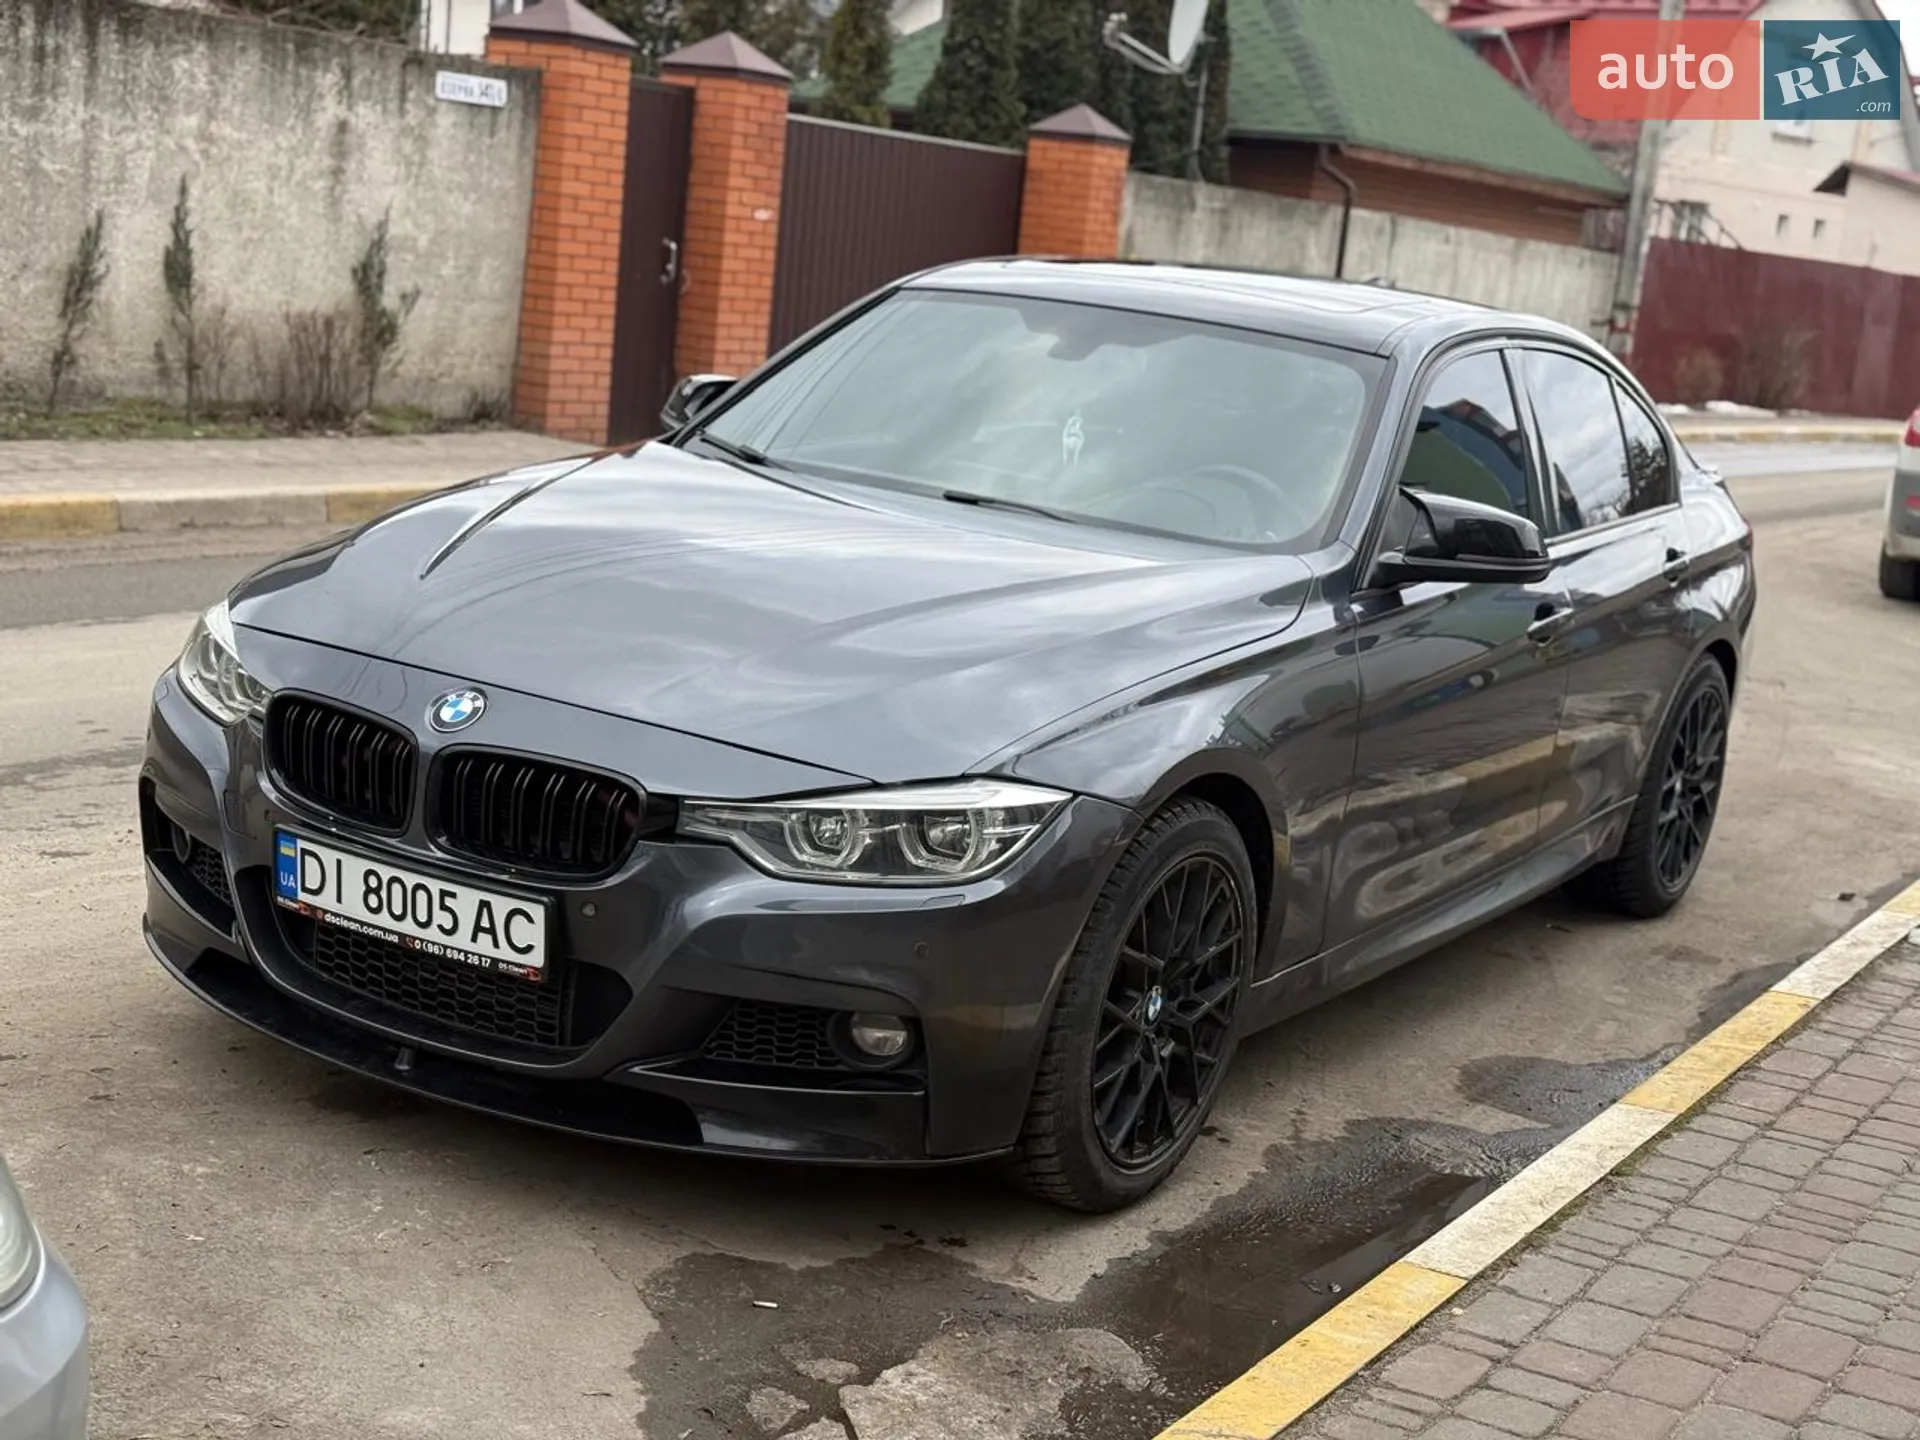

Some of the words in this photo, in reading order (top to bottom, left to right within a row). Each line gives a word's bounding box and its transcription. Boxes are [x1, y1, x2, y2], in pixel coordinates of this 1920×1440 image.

[280, 871, 296, 889] UA
[300, 847, 343, 904] DI
[362, 868, 459, 937] 8005
[469, 898, 536, 956] AC
[324, 912, 399, 943] dsclean.com.ua
[481, 957, 491, 968] 17
